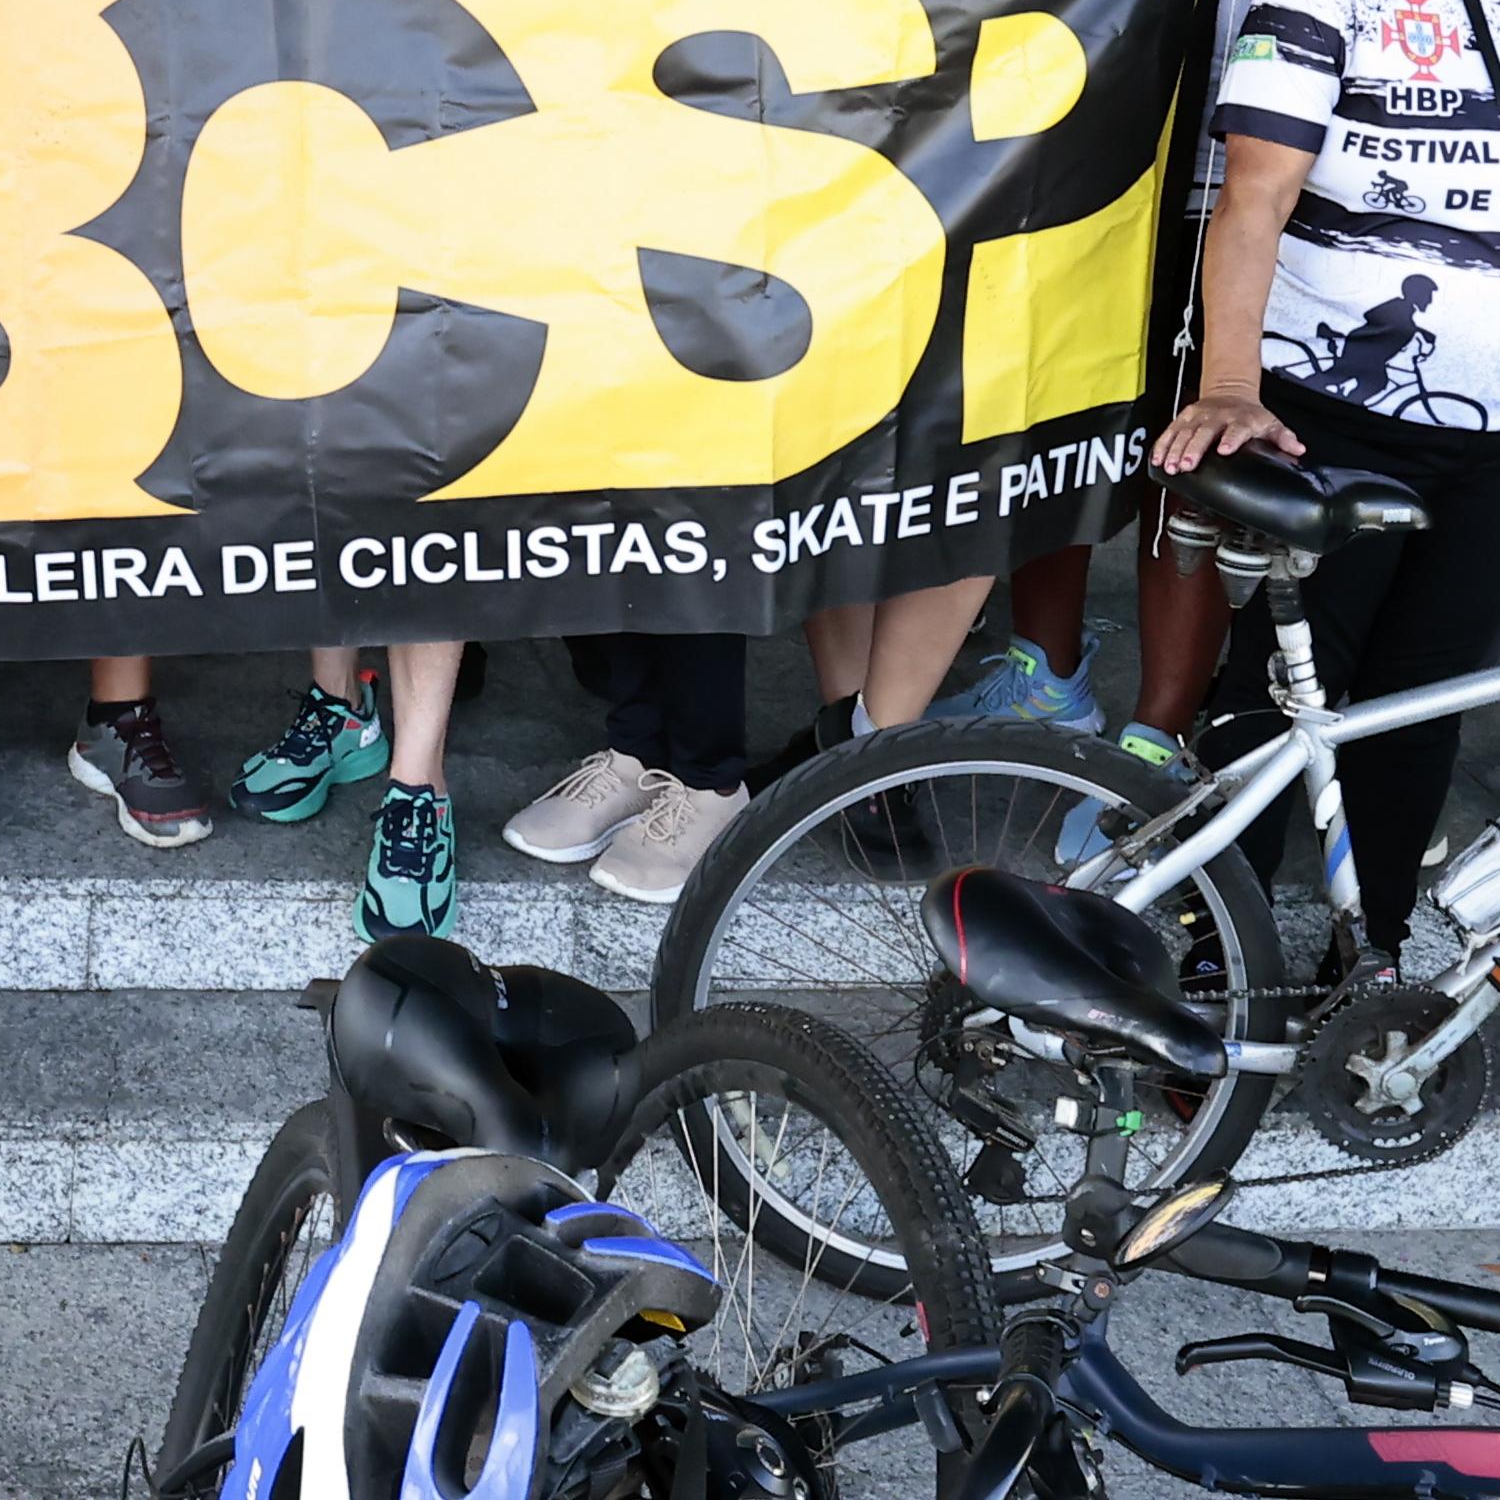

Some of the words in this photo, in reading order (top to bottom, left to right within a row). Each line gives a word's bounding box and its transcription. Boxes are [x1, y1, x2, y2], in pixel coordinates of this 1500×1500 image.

[1390, 85, 1461, 114] HBP
[1342, 131, 1500, 165] FESTIVAL
[1445, 188, 1492, 213] DE
[220, 539, 317, 596] DE
[338, 520, 728, 591] CICLISTAS,
[752, 481, 933, 575] SKATE
[944, 471, 981, 528] E
[999, 428, 1147, 520] PATINS
